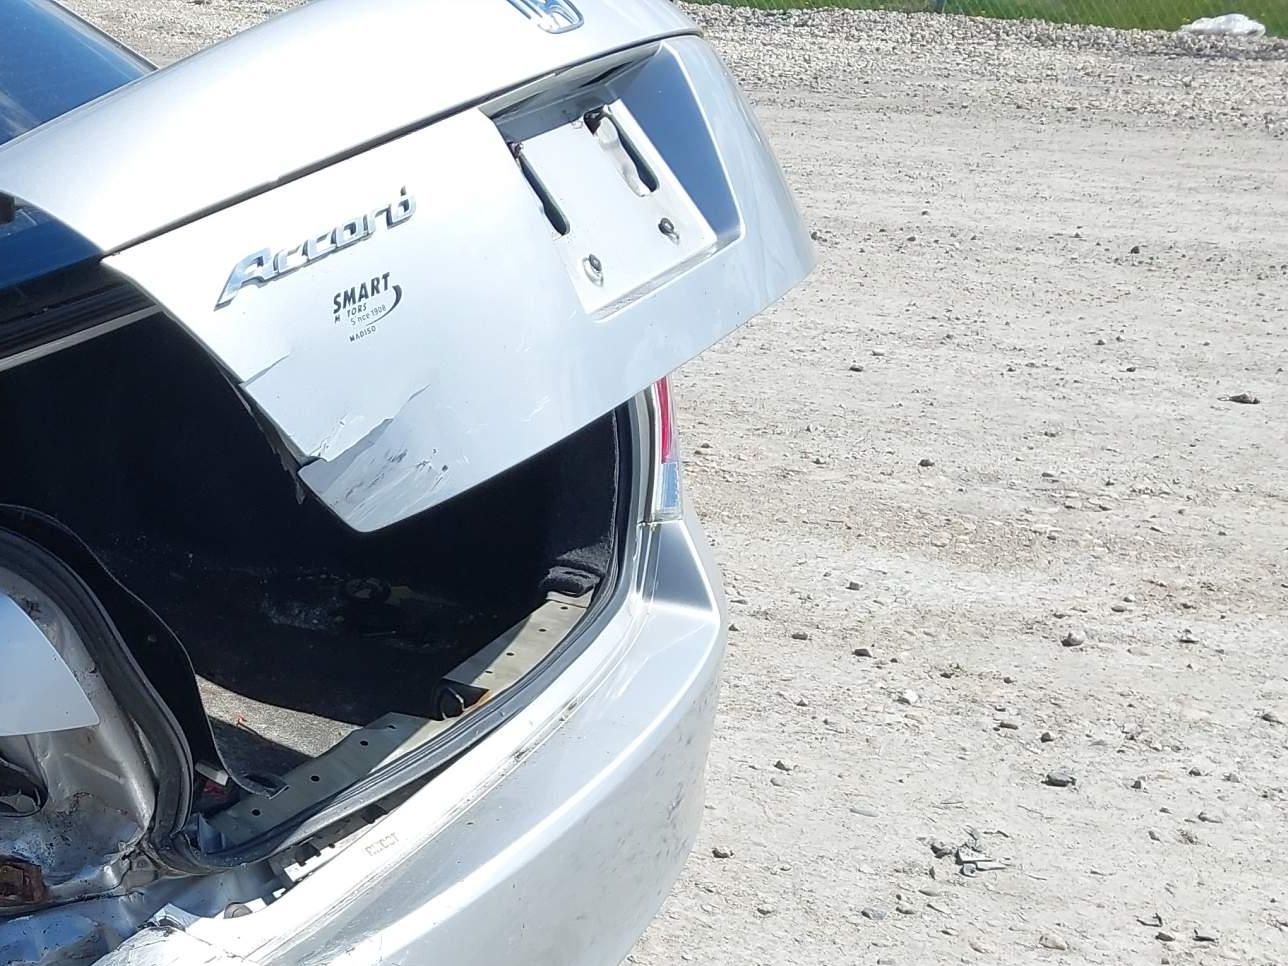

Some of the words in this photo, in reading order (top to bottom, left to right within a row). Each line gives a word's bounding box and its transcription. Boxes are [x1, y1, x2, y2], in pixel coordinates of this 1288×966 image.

[214, 185, 417, 312] Accord
[333, 271, 391, 315] SMART
[334, 302, 367, 325] MTORS
[350, 312, 371, 326] Snce
